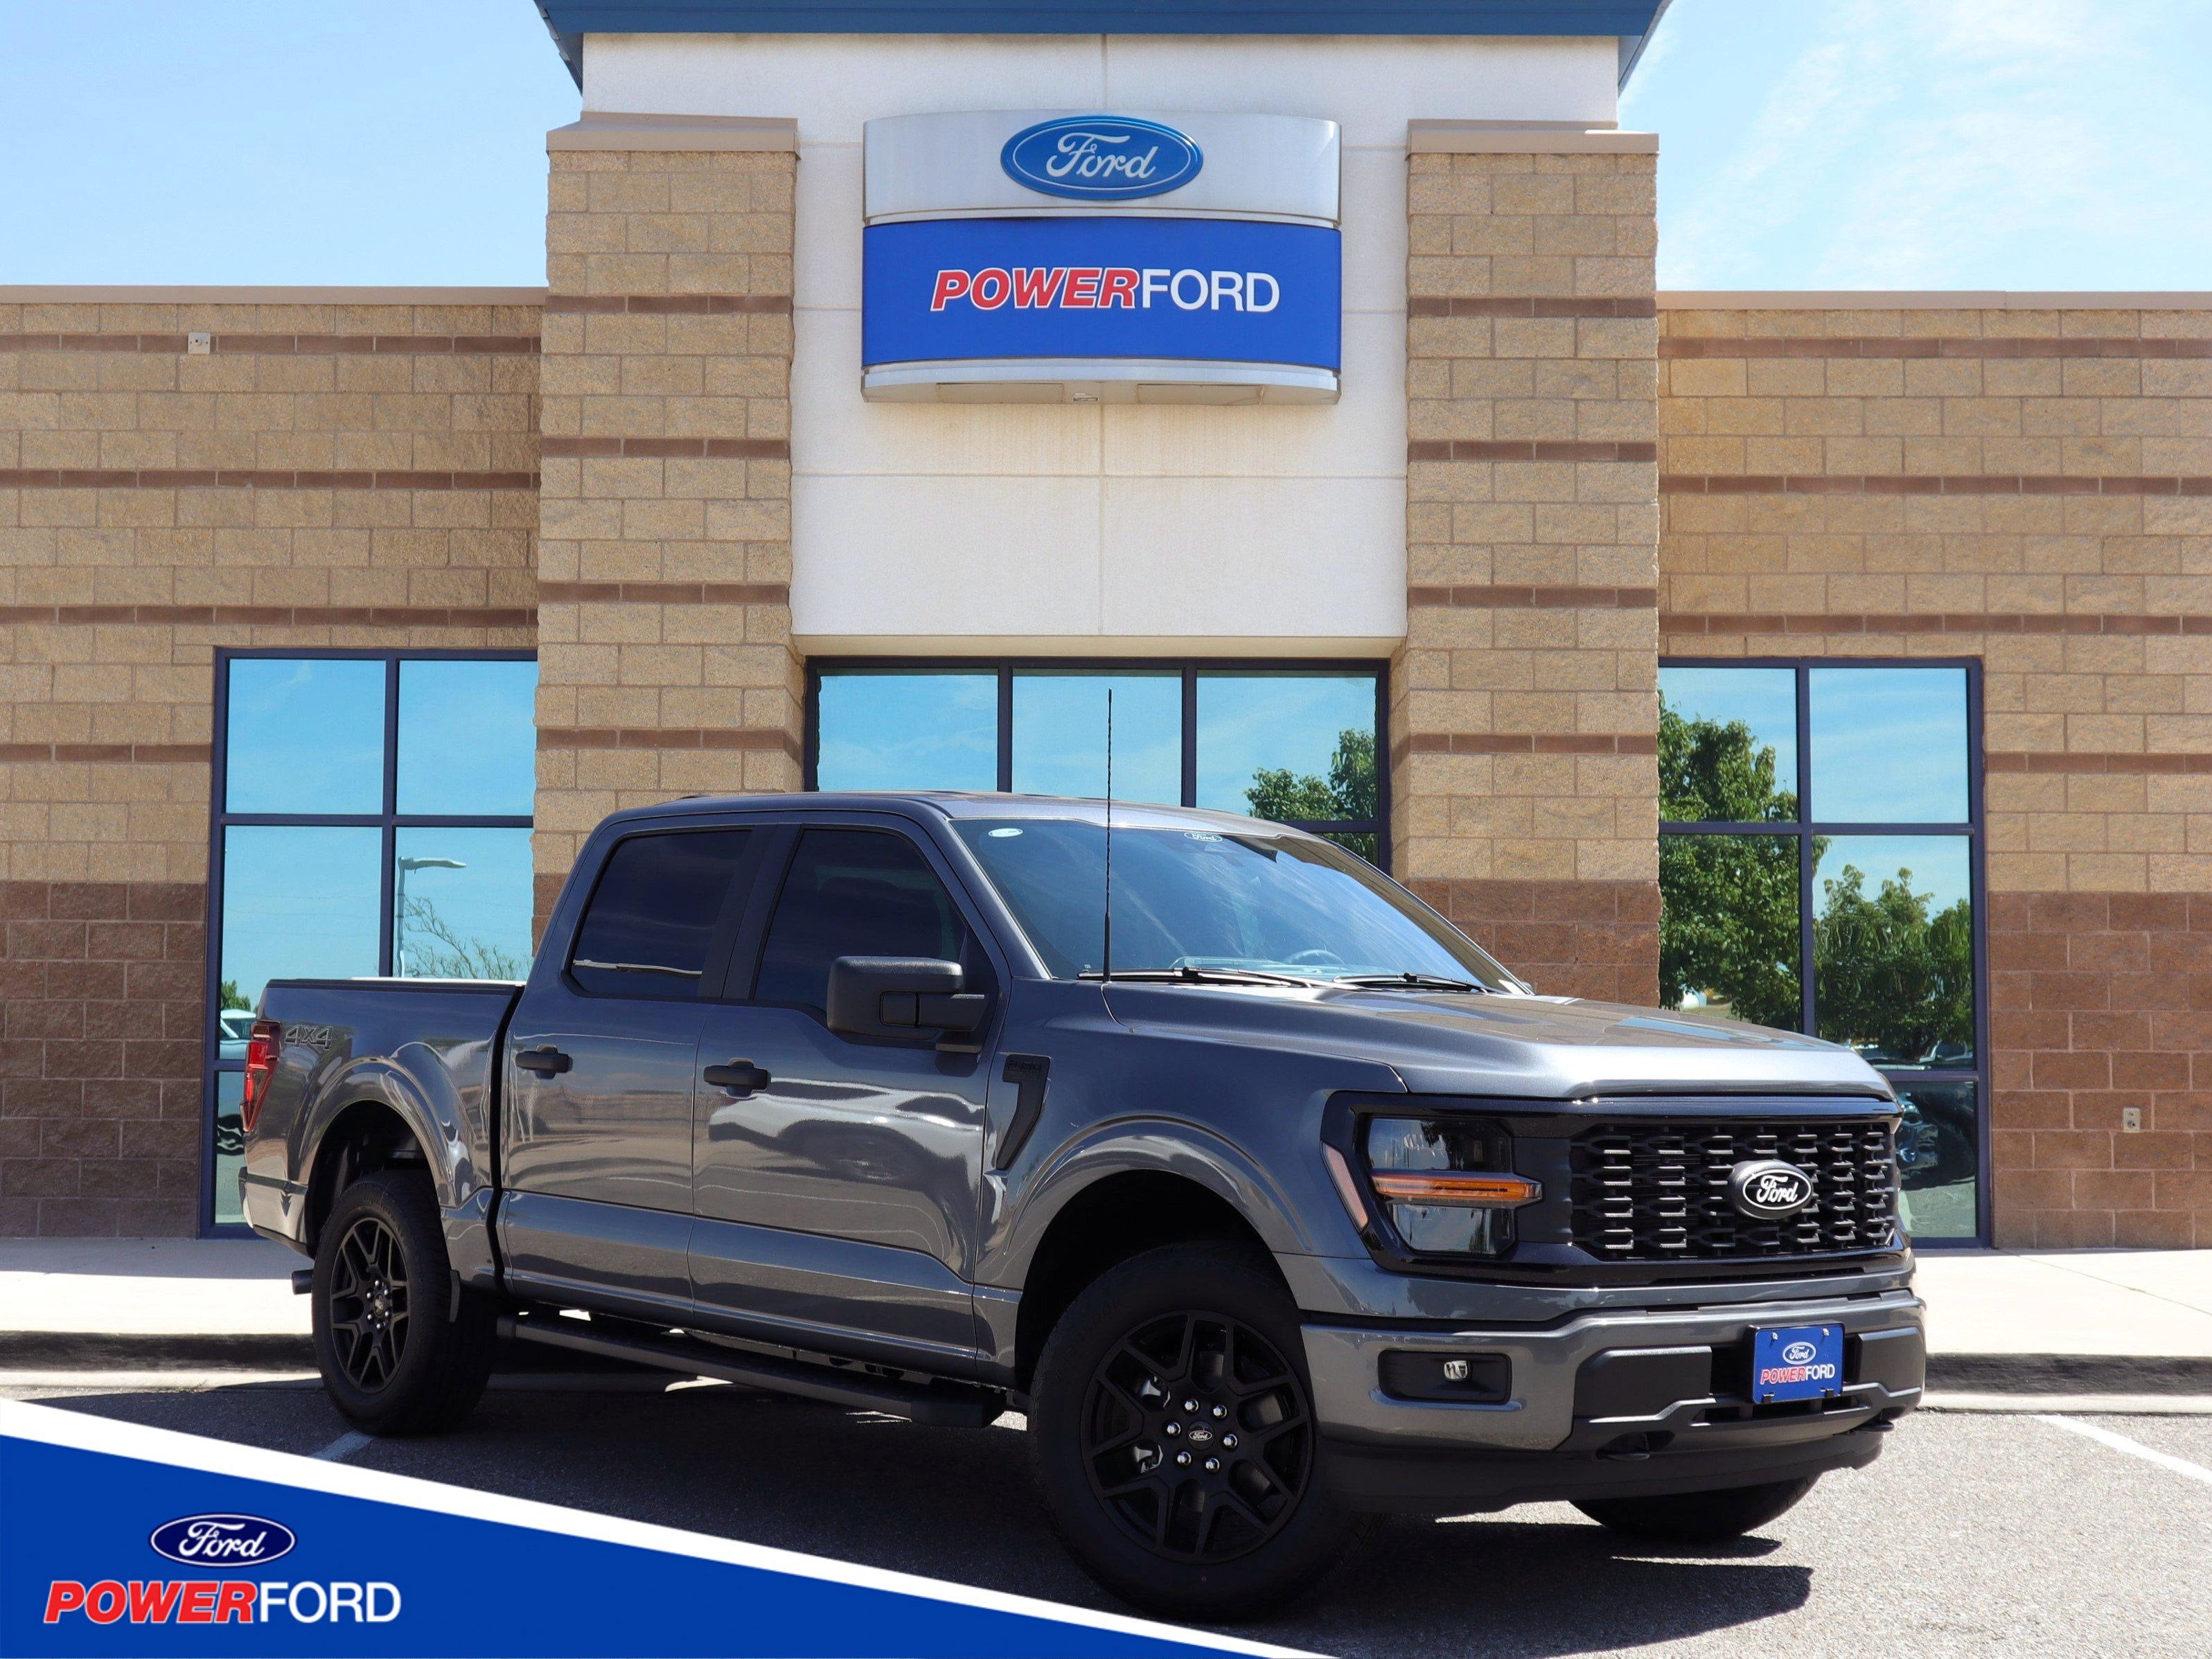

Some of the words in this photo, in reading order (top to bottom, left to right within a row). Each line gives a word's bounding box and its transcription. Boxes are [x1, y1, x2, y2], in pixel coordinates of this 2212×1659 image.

[1046, 132, 1160, 179] Ford
[1756, 1175, 1798, 1203] Ford
[1789, 1346, 1810, 1360] Ford
